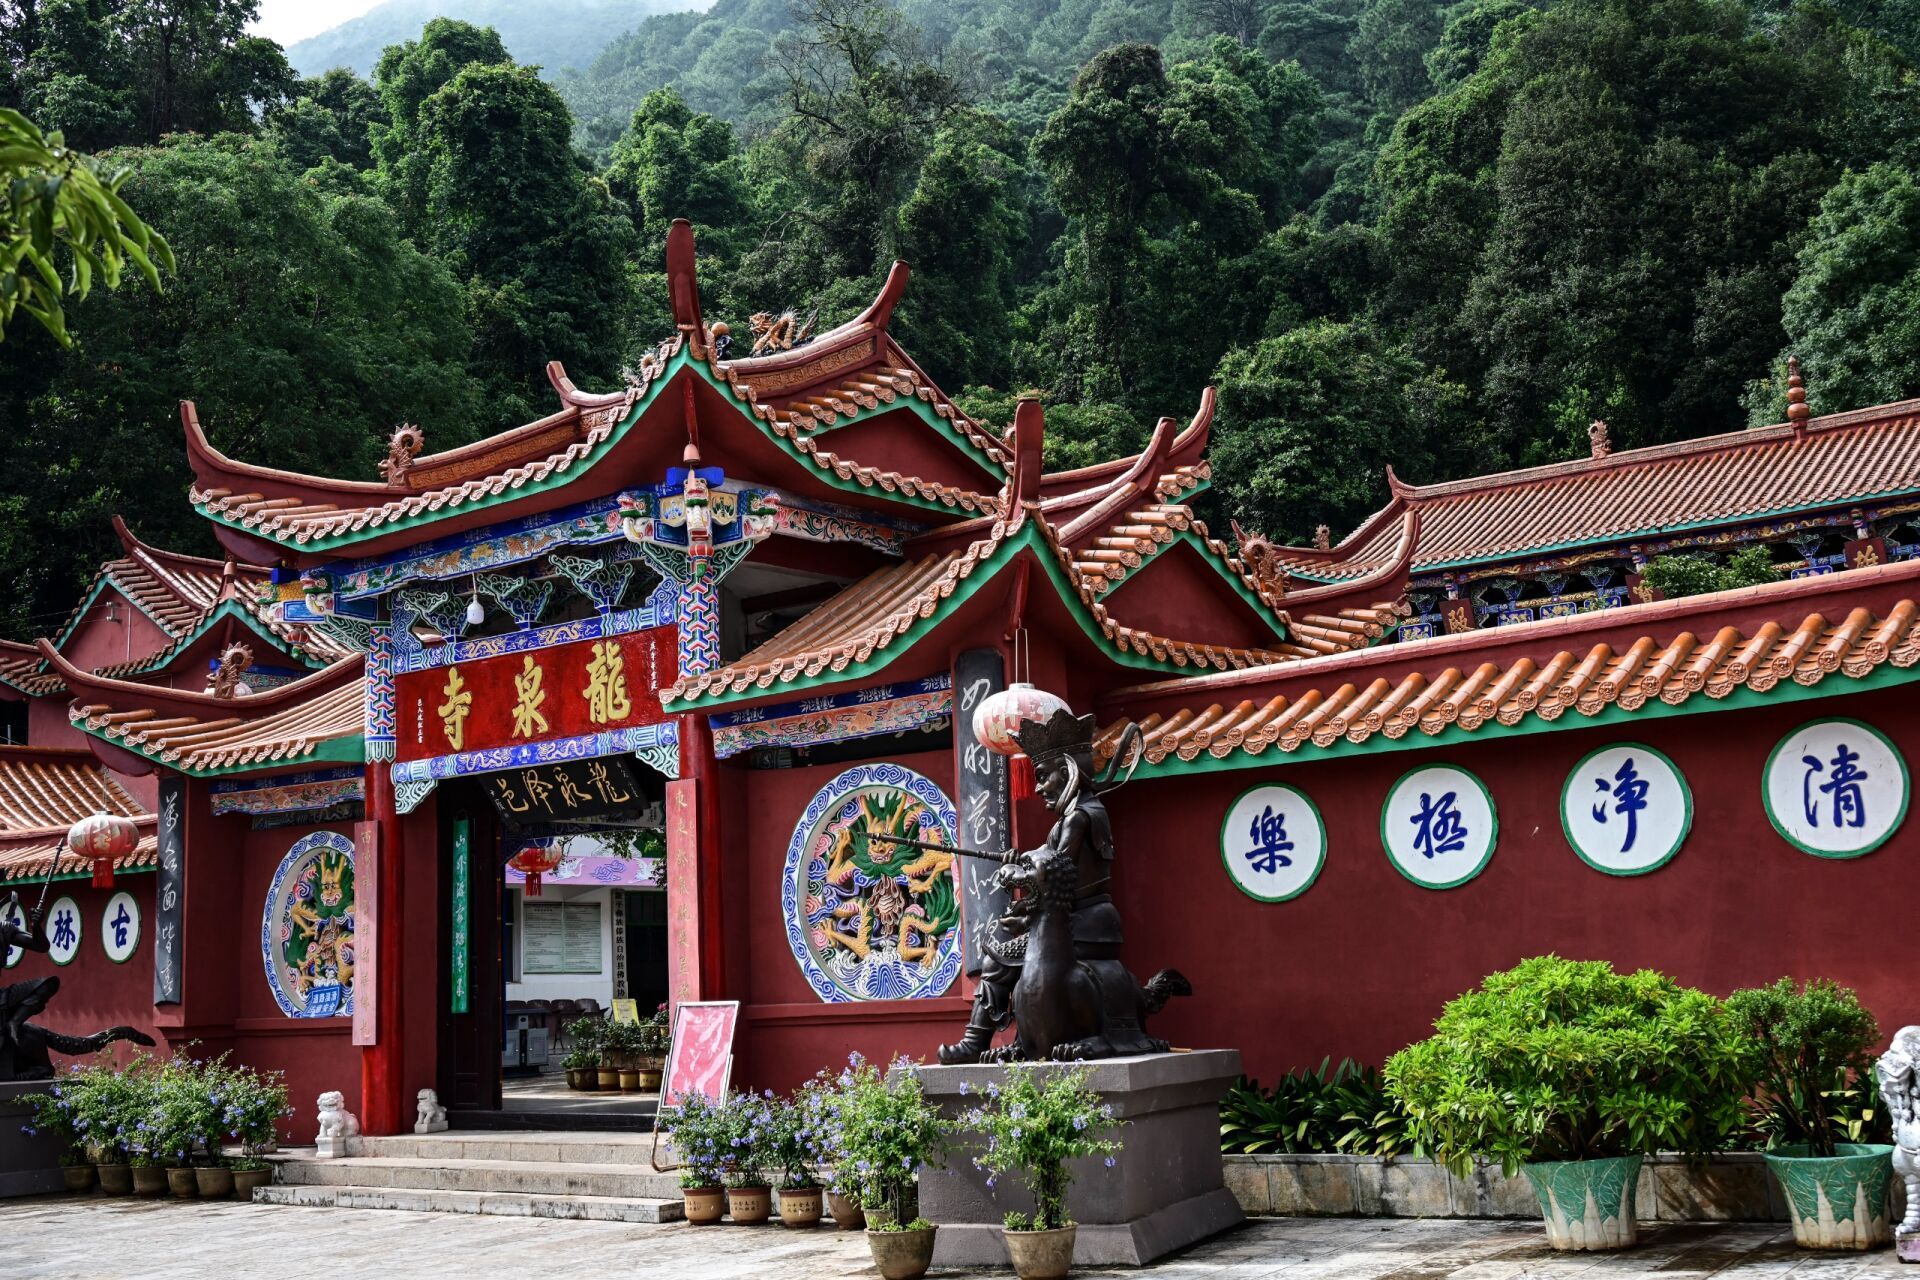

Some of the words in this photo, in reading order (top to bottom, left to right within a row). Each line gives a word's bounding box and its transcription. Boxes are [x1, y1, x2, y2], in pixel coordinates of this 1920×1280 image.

[1803, 743, 1868, 829] 清
[1245, 805, 1294, 874] 樂
[52, 909, 76, 951] 林
[111, 903, 130, 948] 古
